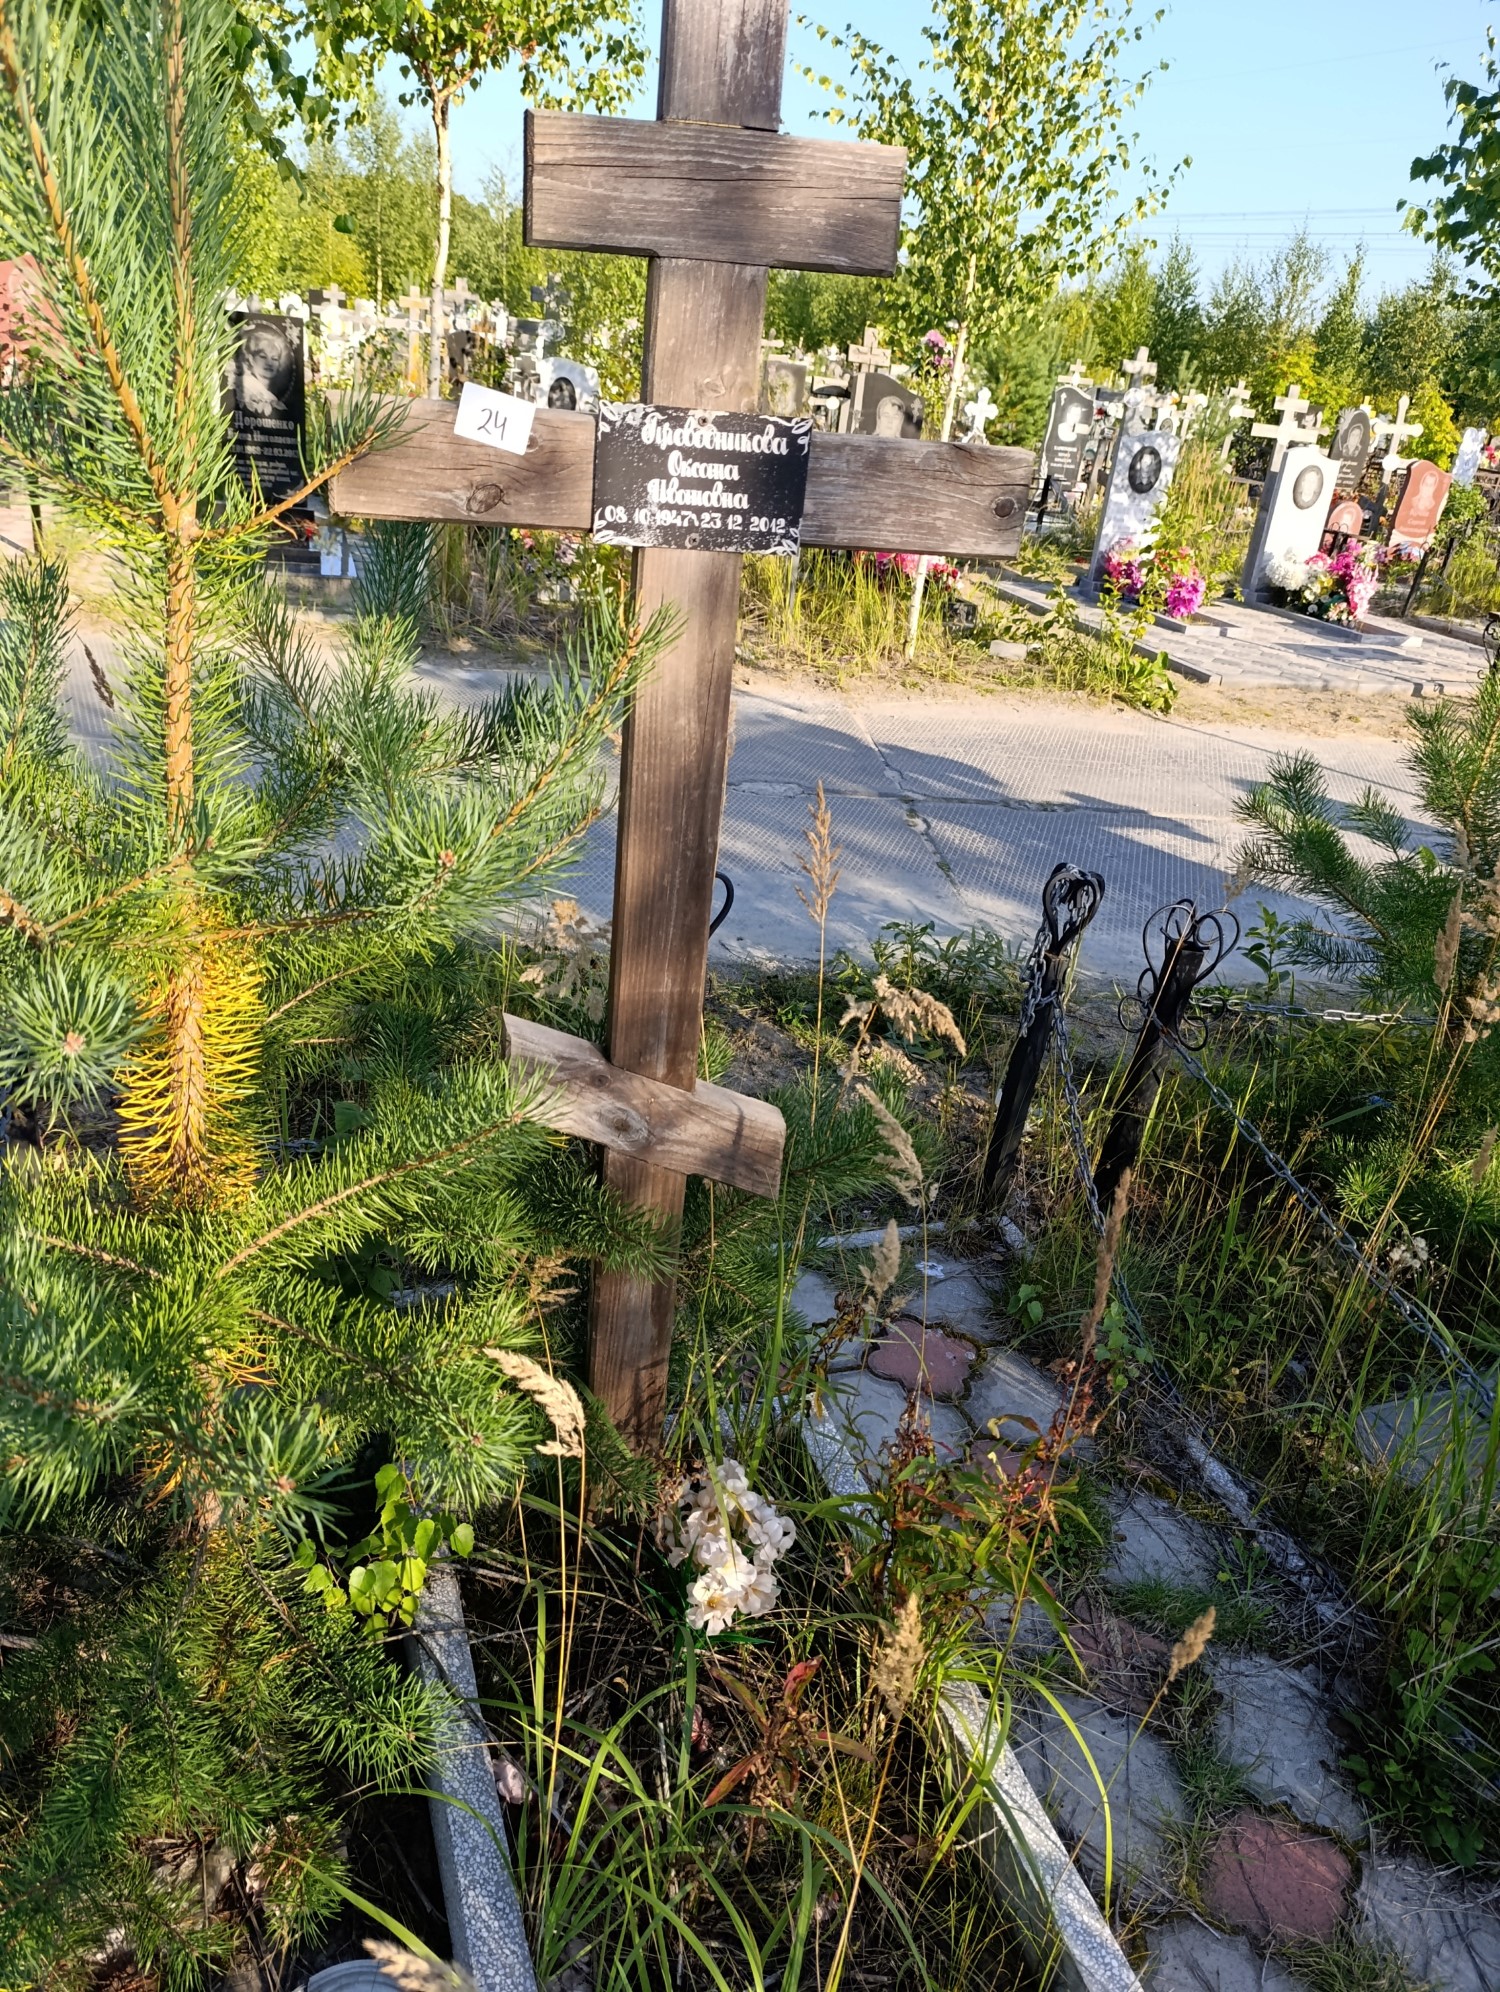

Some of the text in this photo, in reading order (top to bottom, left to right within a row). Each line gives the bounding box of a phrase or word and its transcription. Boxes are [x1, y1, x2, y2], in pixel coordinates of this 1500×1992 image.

[476, 408, 508, 441] 24
[641, 411, 790, 455] Проводникова
[668, 449, 740, 482] Оксана
[646, 478, 750, 511] Ивановна
